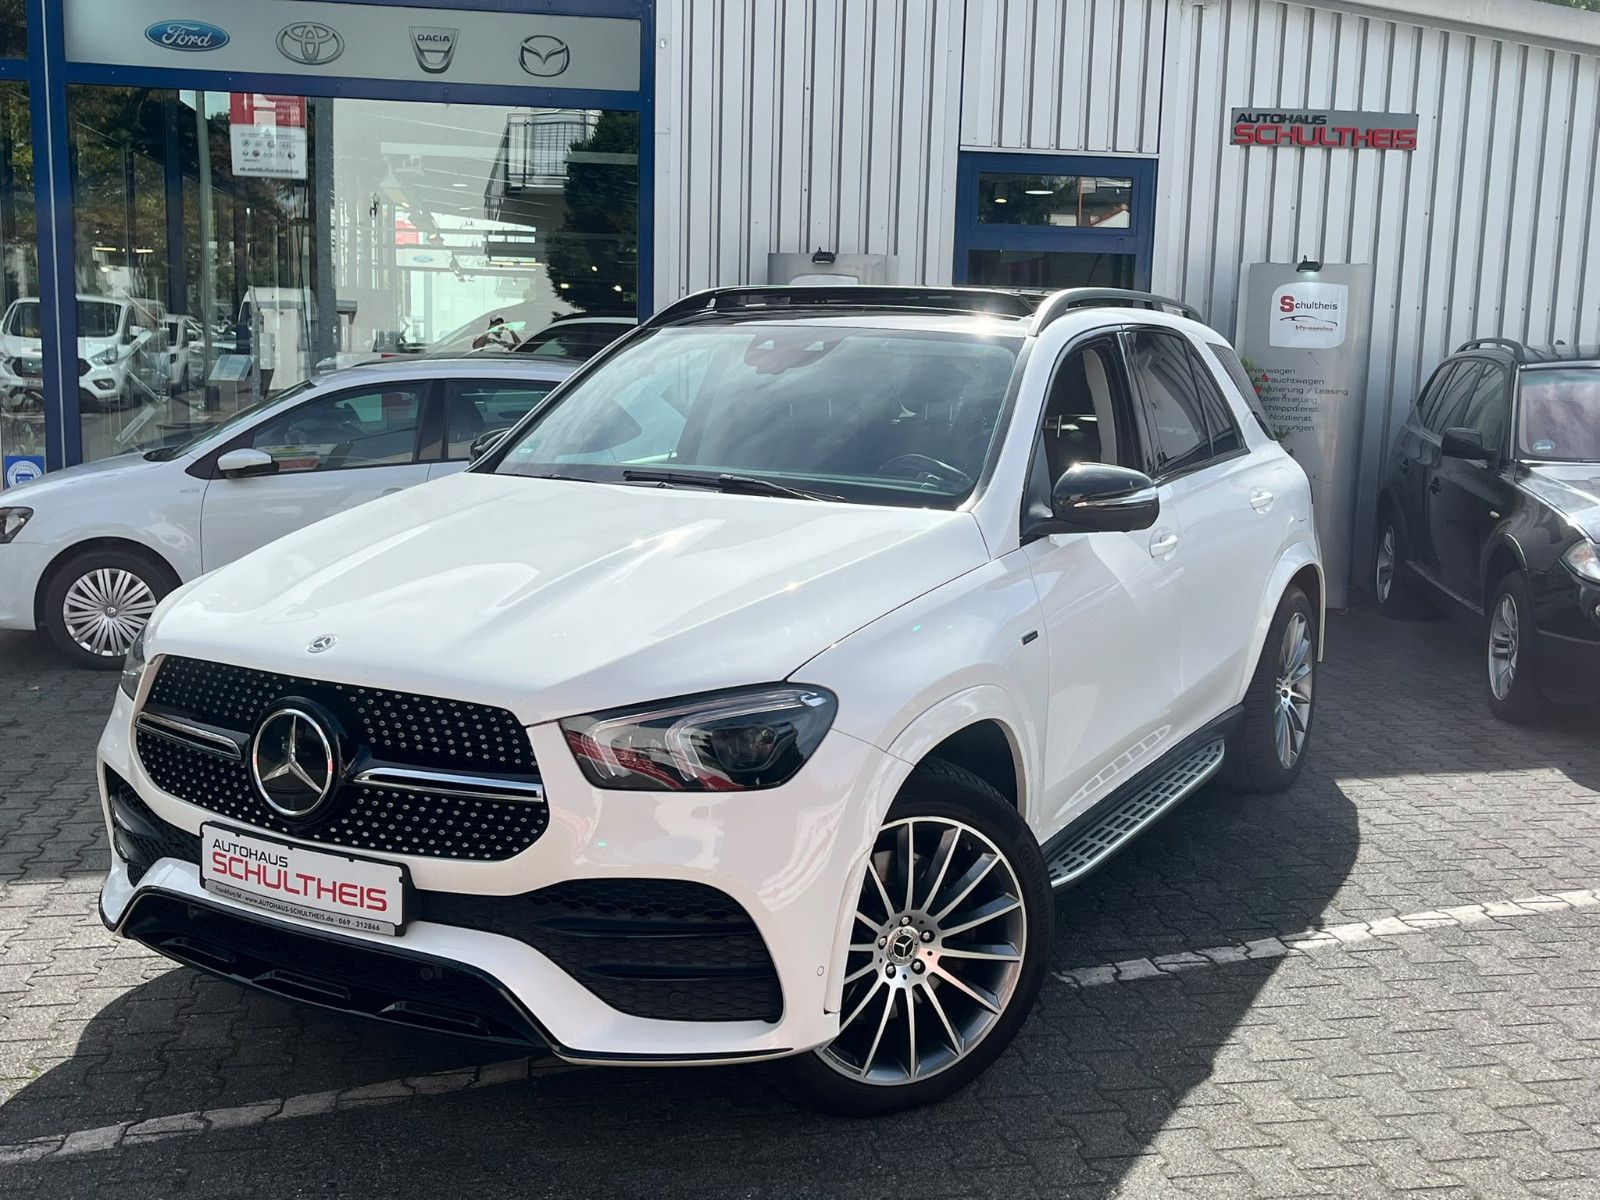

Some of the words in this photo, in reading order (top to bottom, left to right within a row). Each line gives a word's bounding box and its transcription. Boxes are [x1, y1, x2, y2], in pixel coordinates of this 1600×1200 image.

[161, 24, 212, 47] Ford
[417, 34, 450, 42] DACIA
[1236, 113, 1327, 125] AUTOHAUS
[1234, 124, 1417, 149] SCHULTHEIS
[1280, 295, 1338, 313] Schultheis
[1314, 387, 1349, 396] Leasing
[1269, 413, 1312, 421] Notdienst
[213, 839, 288, 868] AUTOHAUS
[213, 851, 387, 912] SCHULTHEIS
[245, 896, 334, 923] www.AUTOHAUS-SCHULTHEIS.de
[338, 916, 351, 926] 069
[356, 920, 381, 932] 312866
